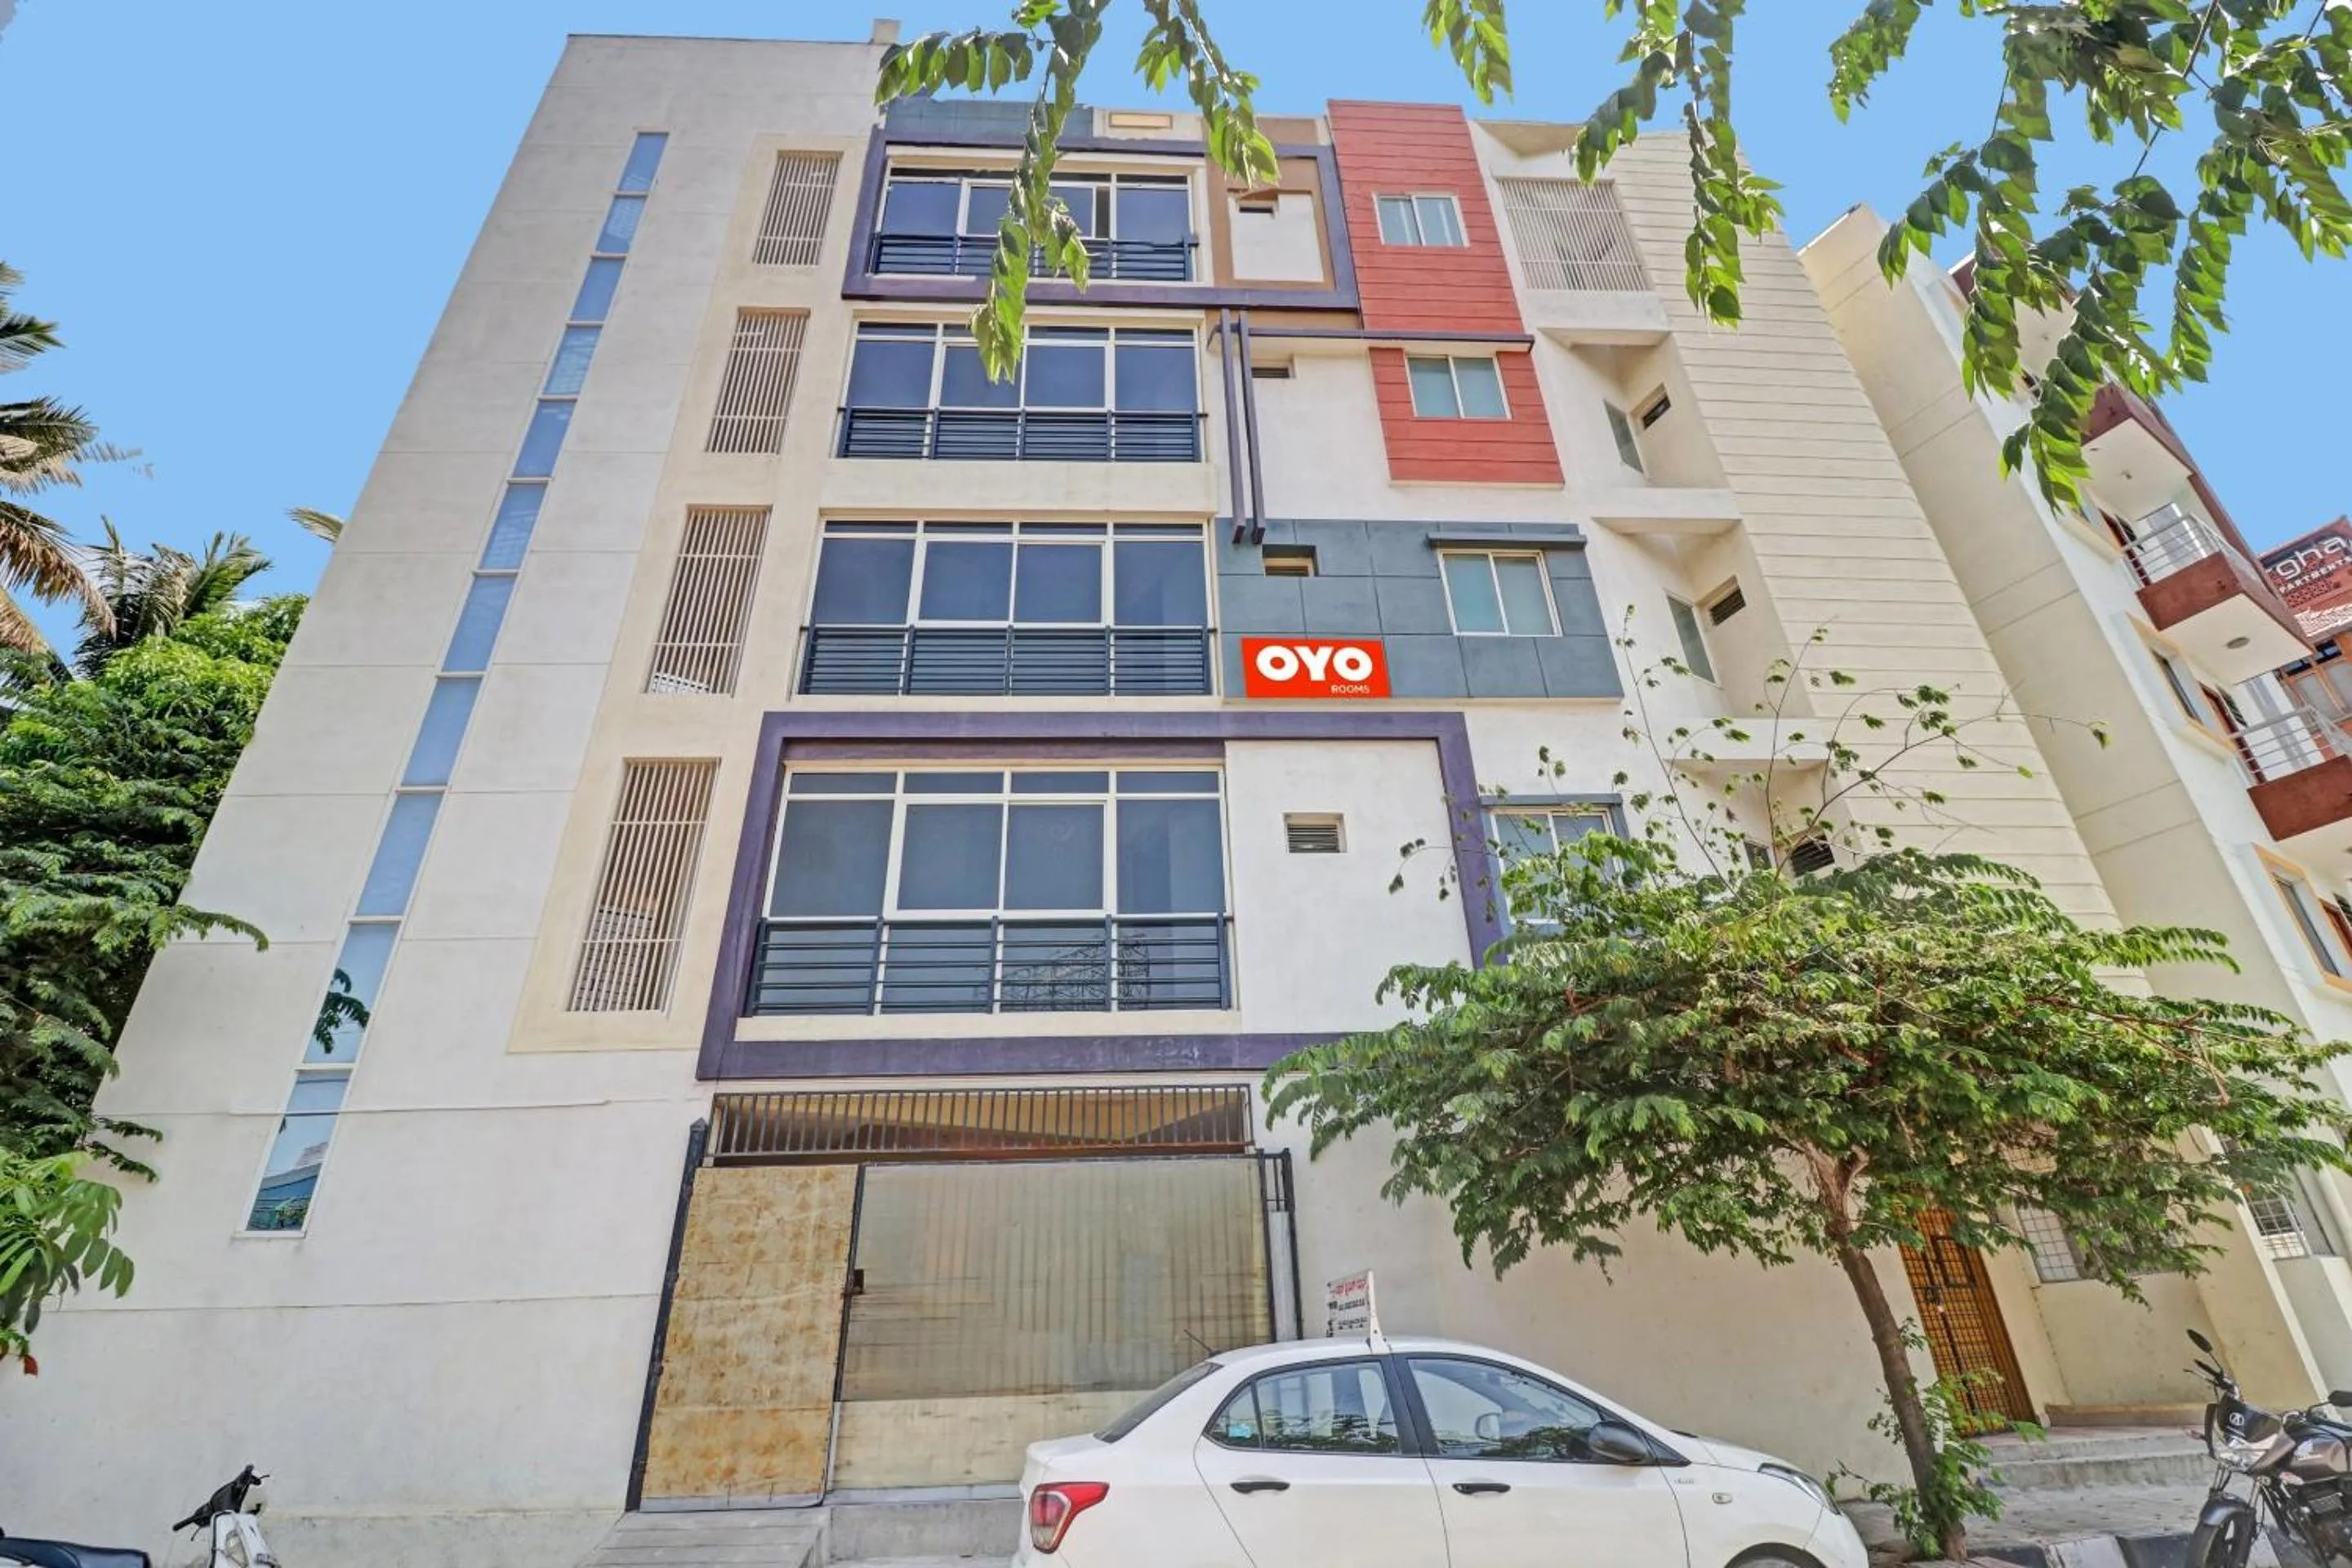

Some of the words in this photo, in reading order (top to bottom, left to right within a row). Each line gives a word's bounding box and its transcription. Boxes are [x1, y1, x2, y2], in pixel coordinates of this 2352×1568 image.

[2265, 537, 2346, 581] gha
[1256, 645, 1374, 682] OYO
[1330, 684, 1370, 694] ROOMS
